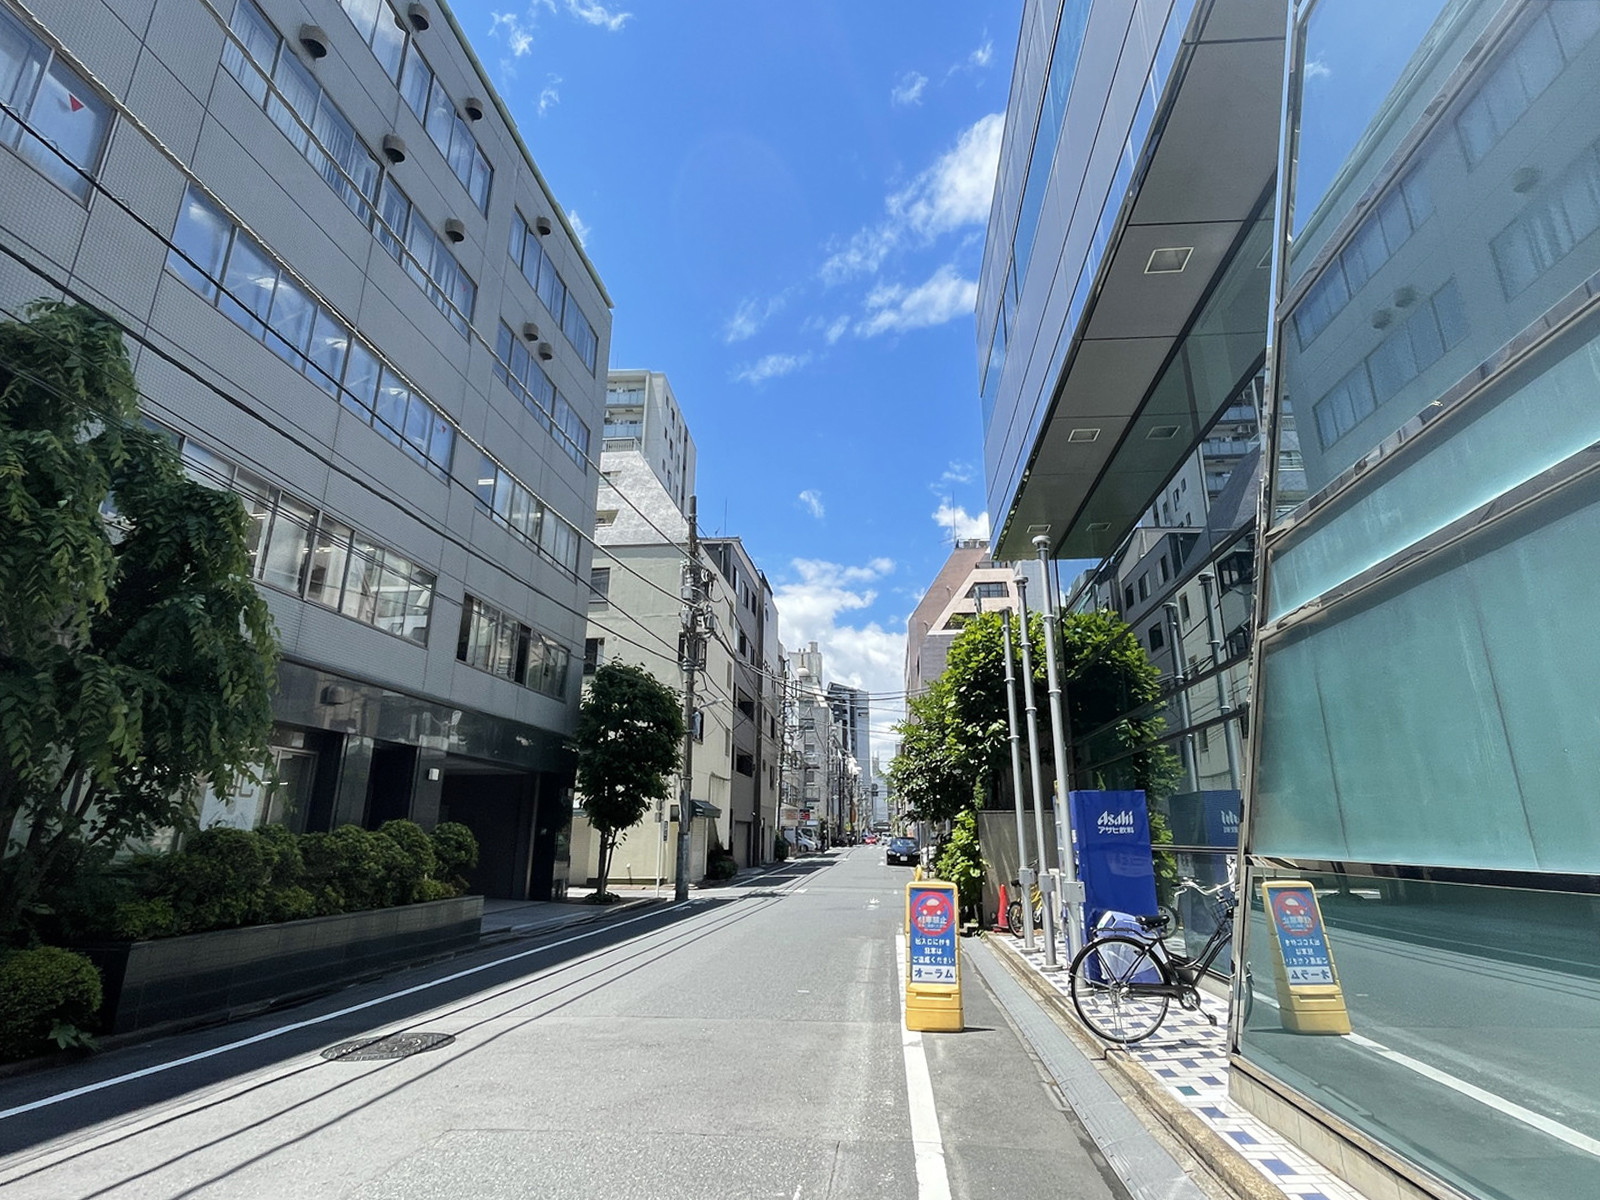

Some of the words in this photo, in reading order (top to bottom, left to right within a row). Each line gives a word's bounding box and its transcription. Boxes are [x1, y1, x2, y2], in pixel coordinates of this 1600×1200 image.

[1097, 810, 1134, 825] Asahi
[1097, 826, 1135, 834] アサヒ飲料
[914, 968, 953, 978] オーラム
